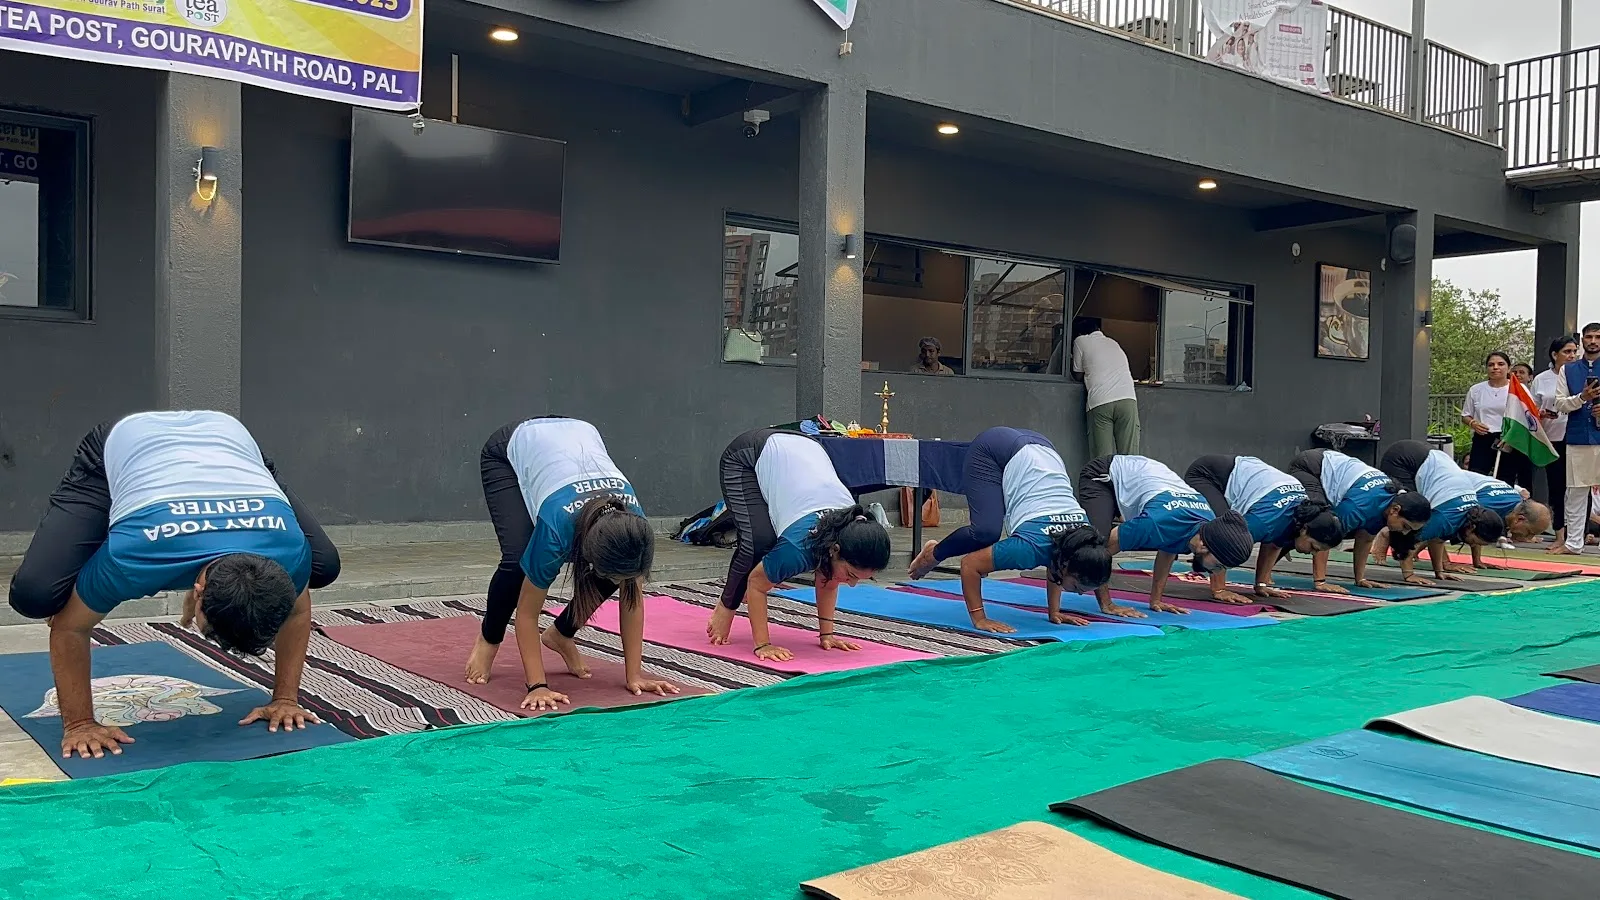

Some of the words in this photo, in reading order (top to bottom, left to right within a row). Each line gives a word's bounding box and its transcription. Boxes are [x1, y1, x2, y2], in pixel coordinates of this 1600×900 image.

[120, 0, 140, 11] Path
[143, 3, 166, 14] Surat
[186, 0, 220, 13] tea
[187, 9, 220, 23] POST
[50, 14, 124, 49] POST,
[131, 26, 287, 74] GOURAVPATH
[293, 56, 357, 91] ROAD,
[362, 70, 403, 94] PAL
[572, 478, 626, 494] CENTER
[166, 498, 266, 515] CENTER
[1162, 499, 1190, 511] YOGA
[142, 519, 219, 542] YOGA
[224, 515, 287, 531] VIJAY
